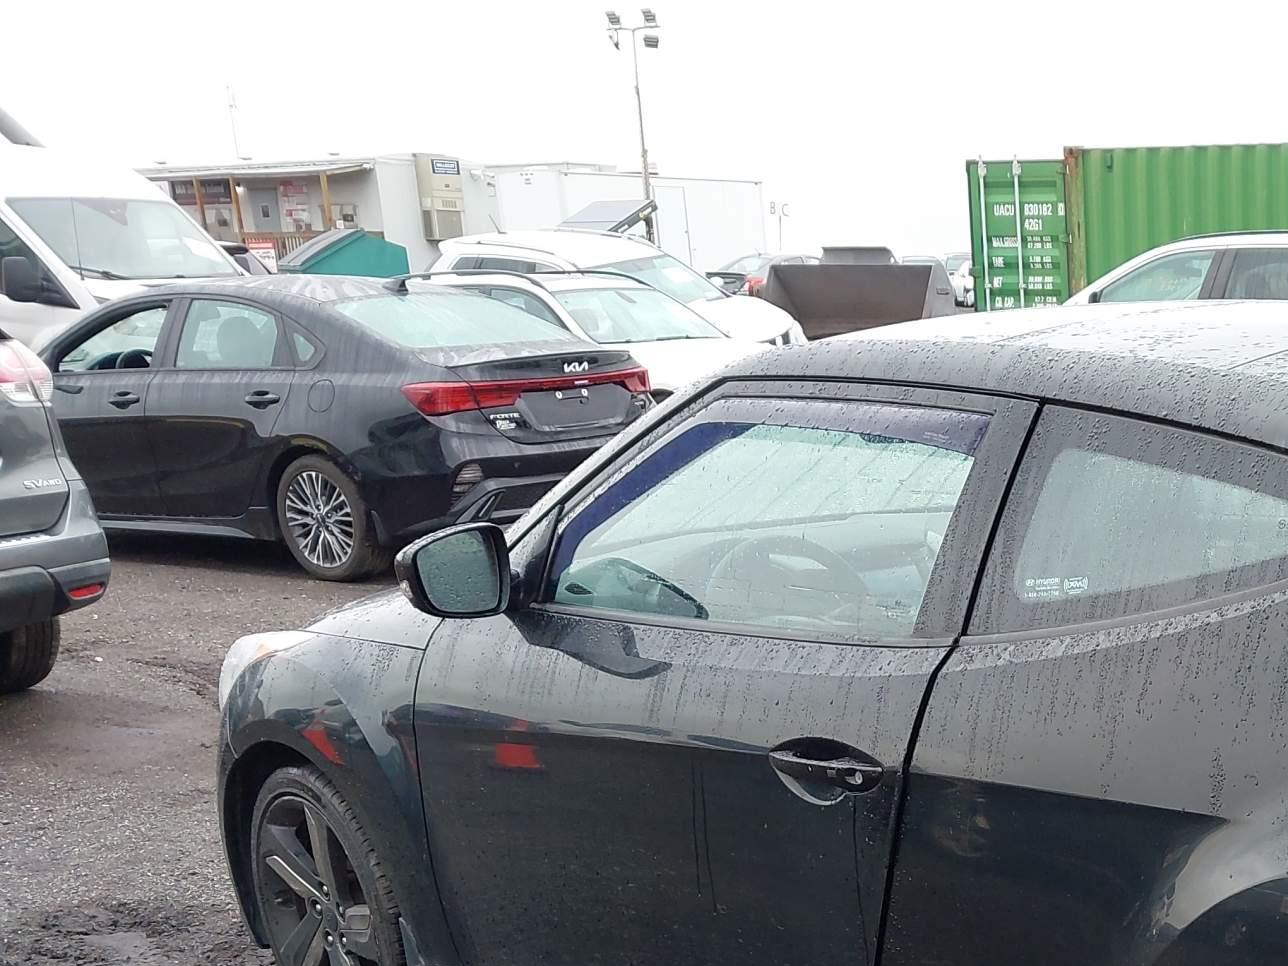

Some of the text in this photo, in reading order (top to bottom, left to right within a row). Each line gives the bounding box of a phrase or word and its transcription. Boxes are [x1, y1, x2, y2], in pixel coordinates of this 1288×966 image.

[993, 204, 1015, 216] UACU
[1023, 203, 1053, 216] 830182
[1023, 219, 1043, 231] 42G1
[563, 361, 589, 373] KIA
[489, 412, 521, 420] FORTE
